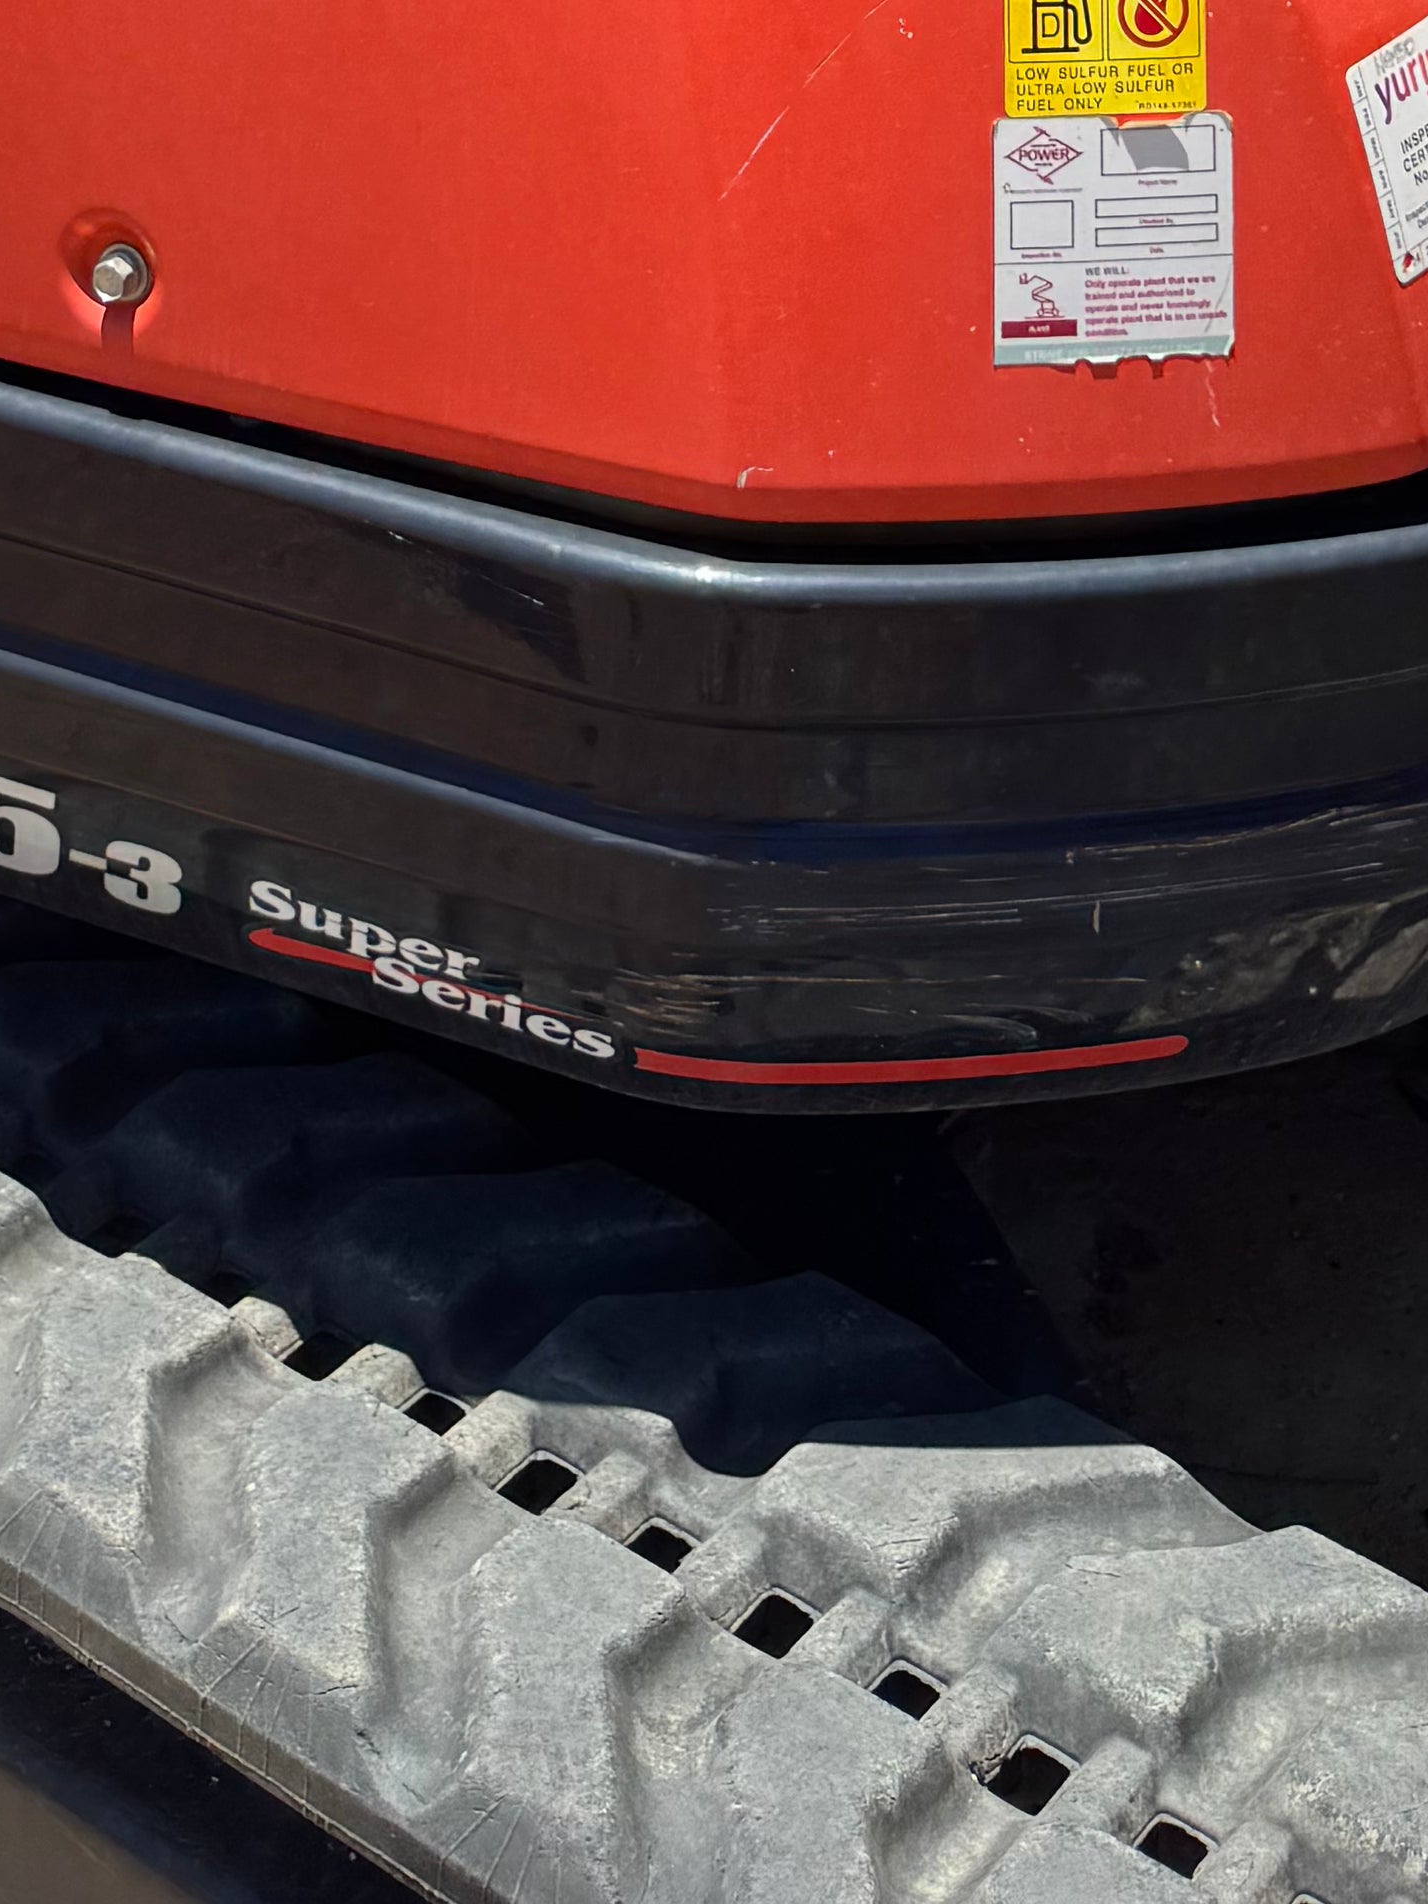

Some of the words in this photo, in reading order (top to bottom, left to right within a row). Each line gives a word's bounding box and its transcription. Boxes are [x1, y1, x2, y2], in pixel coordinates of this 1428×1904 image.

[1016, 68, 1049, 81] LOW
[1059, 65, 1119, 80] SULFUR
[1128, 63, 1165, 78] FUEL
[1172, 62, 1194, 75] OR
[1017, 81, 1065, 96] ULTRA
[1074, 81, 1107, 94] LOW
[1115, 79, 1175, 93] SULFUR
[1017, 98, 1055, 112] FUEL
[1064, 96, 1103, 111] ONLY
[1018, 148, 1070, 161] POWER
[1085, 267, 1101, 276] WE
[1085, 280, 1105, 289] Only
[1108, 279, 1141, 288] operate
[1143, 277, 1165, 286] plant
[1168, 276, 1185, 284] that
[1085, 292, 1116, 300] trained
[1119, 290, 1135, 299] and
[1085, 305, 1118, 314] operate
[1121, 303, 1137, 311] and
[1167, 299, 1210, 309] knowingly
[1085, 317, 1118, 325] operate
[1121, 315, 1143, 324] plant
[1145, 313, 1162, 322] that
[248, 879, 482, 982] Super
[370, 957, 616, 1061] Series
